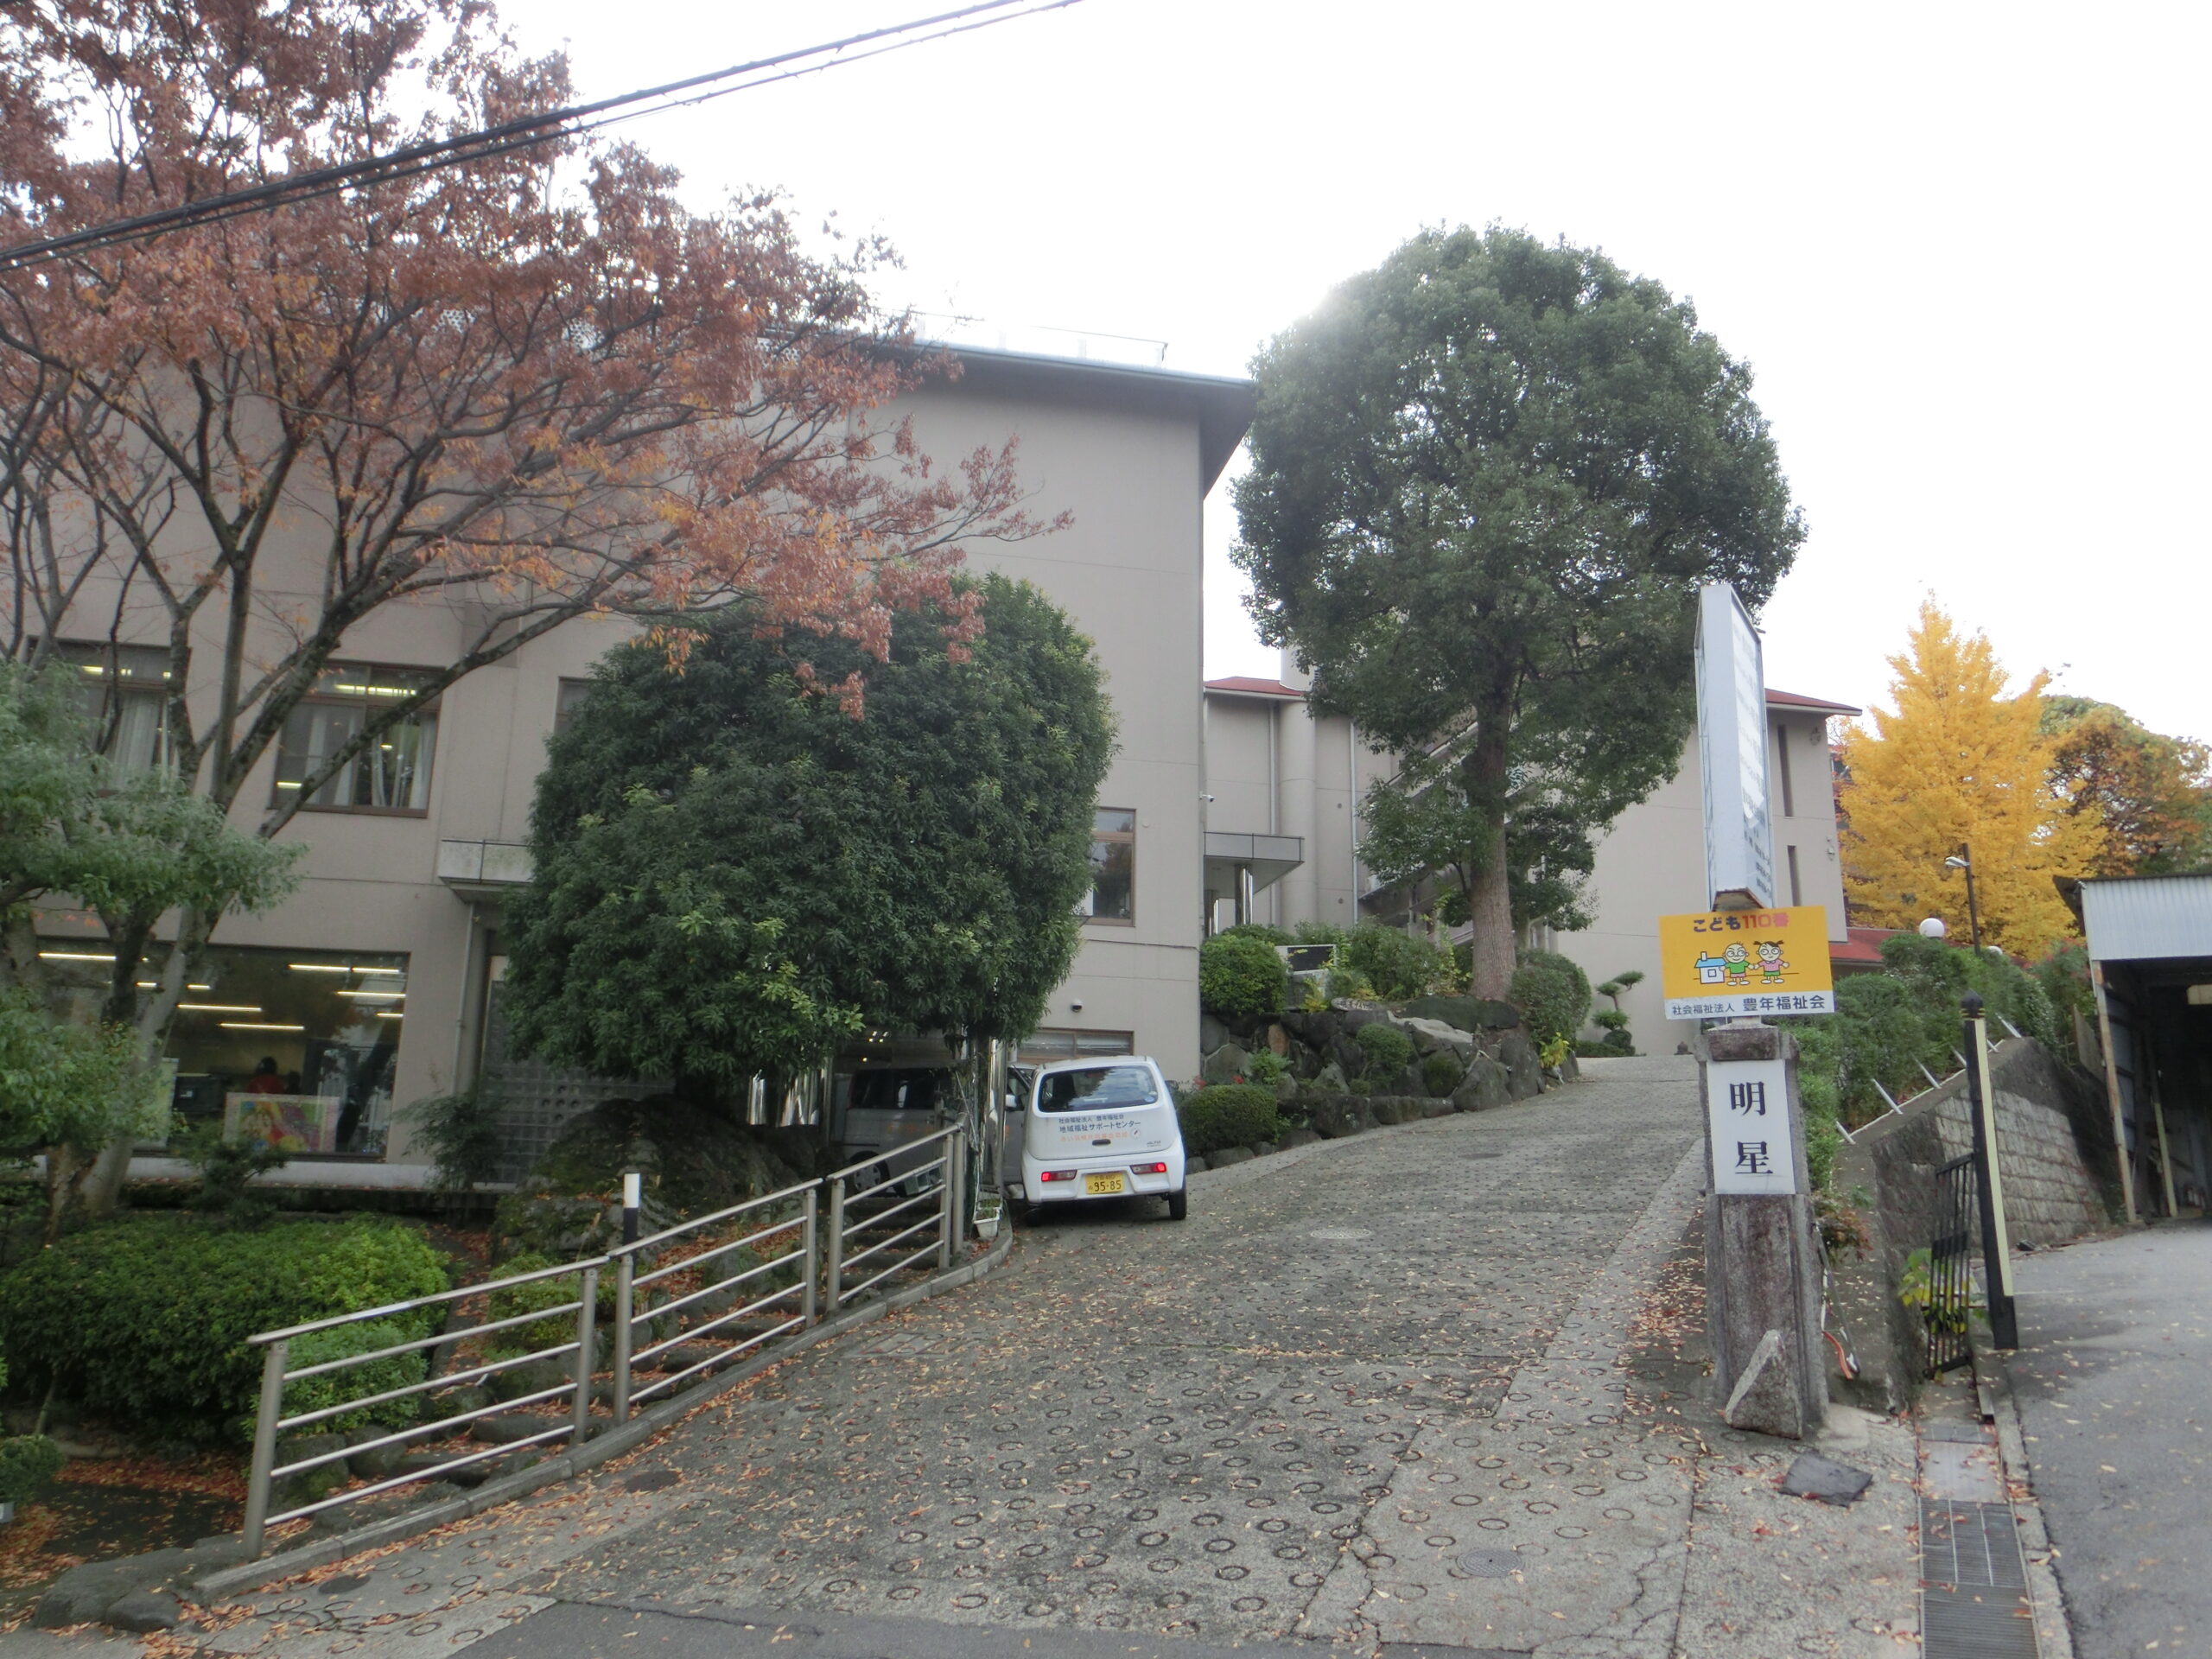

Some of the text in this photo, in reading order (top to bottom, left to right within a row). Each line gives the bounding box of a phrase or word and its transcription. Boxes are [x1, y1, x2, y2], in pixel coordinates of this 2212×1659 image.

[1693, 912, 1789, 933] こども110番
[1672, 995, 1826, 1016] 社会福祉法人 豊年福祉会
[1059, 1120, 1141, 1134] 地域福祉サポートセンター
[1729, 1081, 1774, 1174] 明星
[1093, 1179, 1122, 1192] 95-85
